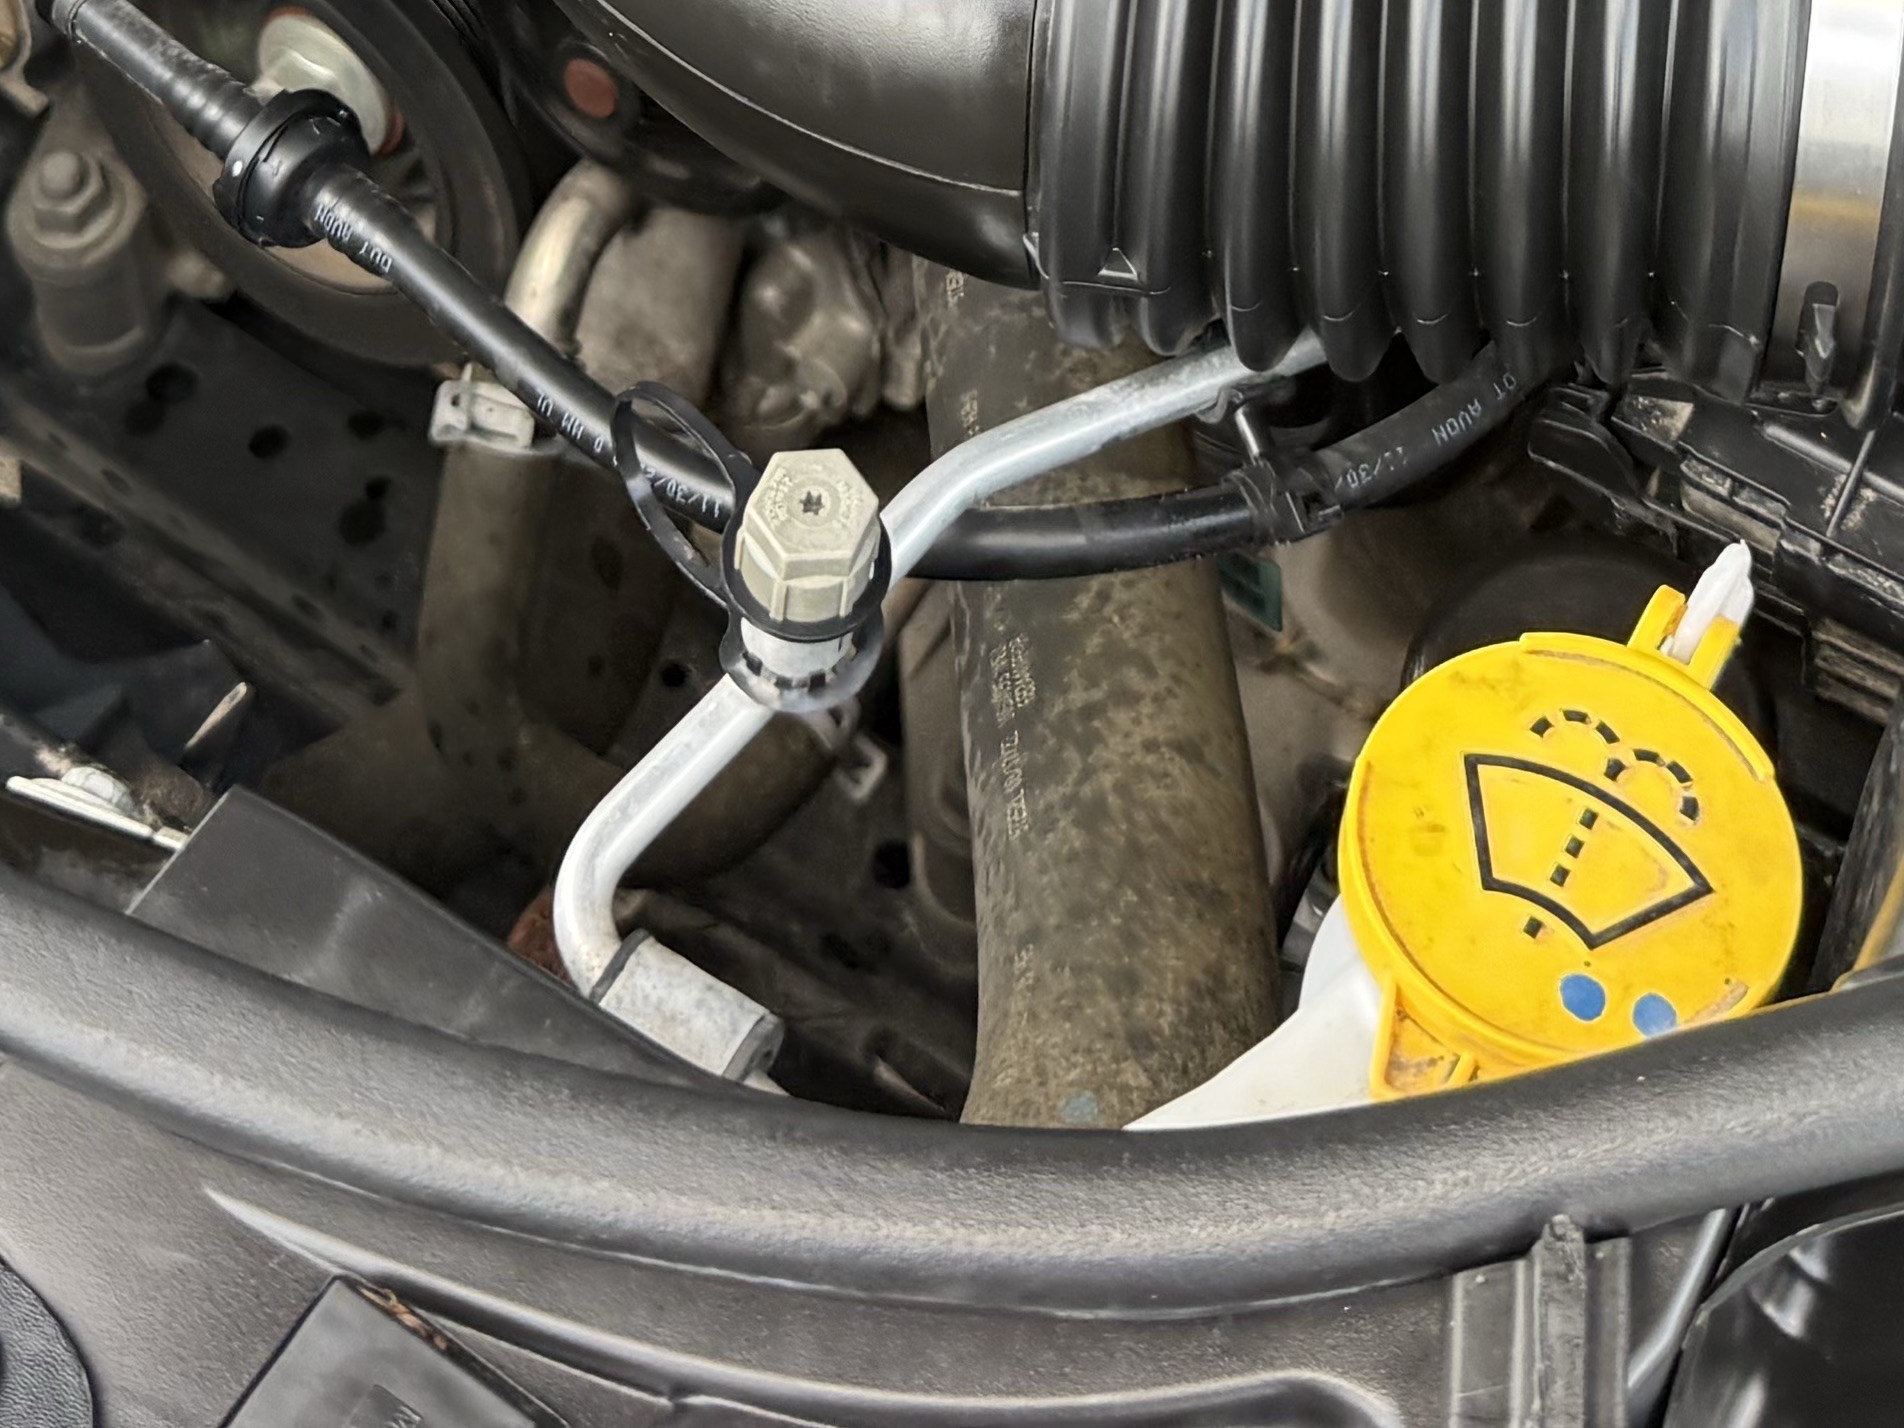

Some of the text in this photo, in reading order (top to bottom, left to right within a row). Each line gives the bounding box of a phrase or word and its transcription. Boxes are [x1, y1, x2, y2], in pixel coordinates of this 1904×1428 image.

[312, 202, 354, 244] AVON
[1429, 396, 1484, 447] AVON
[634, 459, 722, 520] 11/30/2
